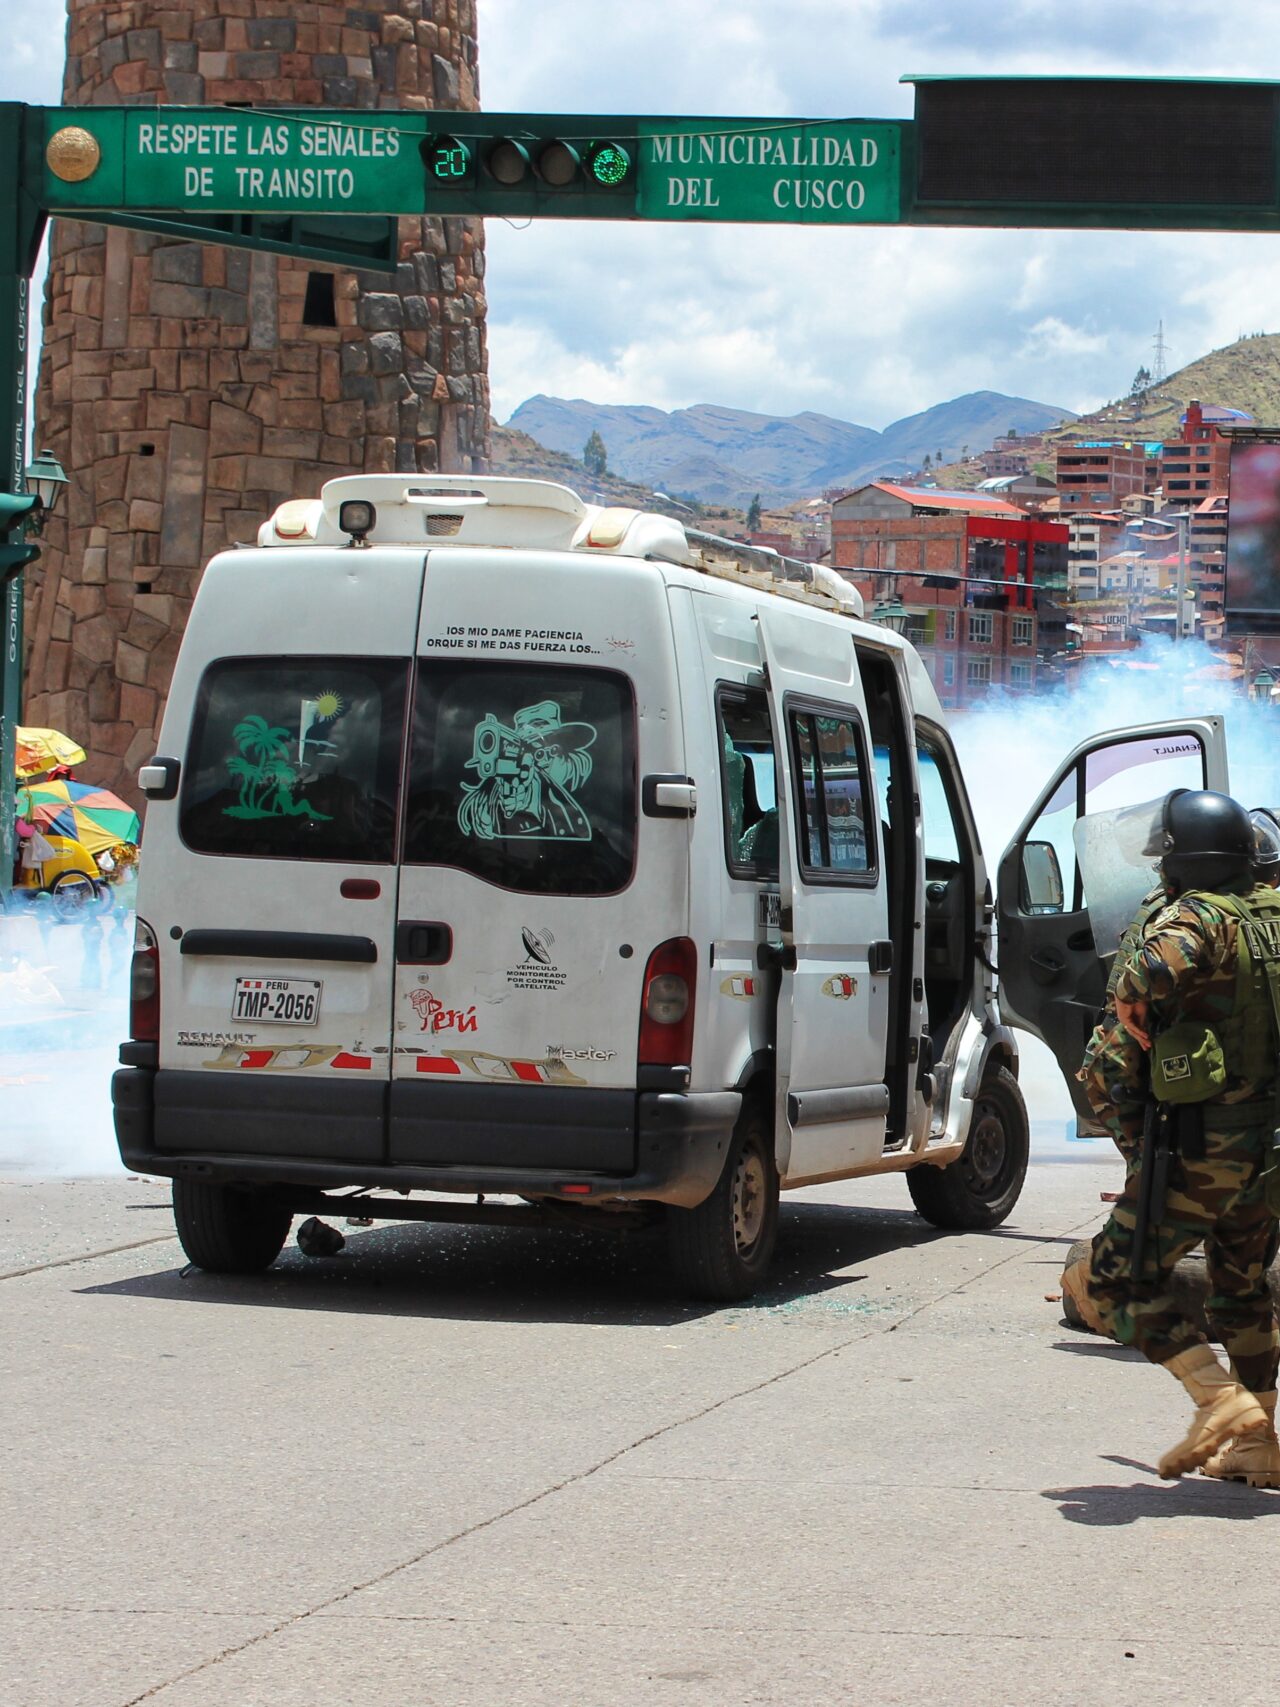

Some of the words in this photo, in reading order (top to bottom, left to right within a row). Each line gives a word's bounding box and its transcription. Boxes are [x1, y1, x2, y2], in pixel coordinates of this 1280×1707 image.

[138, 123, 238, 155] RESPETE
[247, 125, 290, 156] LAS
[300, 121, 400, 157] SEÑALES
[650, 134, 878, 168] MUNICIPALIDAD
[433, 148, 467, 177] 20
[184, 166, 214, 197] DE
[235, 167, 354, 199] TRANSITO
[667, 176, 720, 208] DEL
[773, 178, 866, 210] CUSCO
[18, 278, 27, 352] CUSCO
[16, 364, 25, 404] DEL
[467, 627, 488, 637] MIO
[491, 628, 522, 638] DAME
[524, 629, 583, 641] PACIENCIA
[467, 639, 478, 649] SI
[481, 640, 496, 650] ME
[499, 641, 521, 650] DAS
[524, 642, 567, 652] FUERZA
[506, 970, 567, 979] MONITOREADO
[515, 964, 558, 972] VEHICULO
[265, 981, 289, 991] PERU
[514, 983, 558, 991] SATELITAL
[236, 991, 316, 1021] TMP-2056
[420, 999, 478, 1033] Perú
